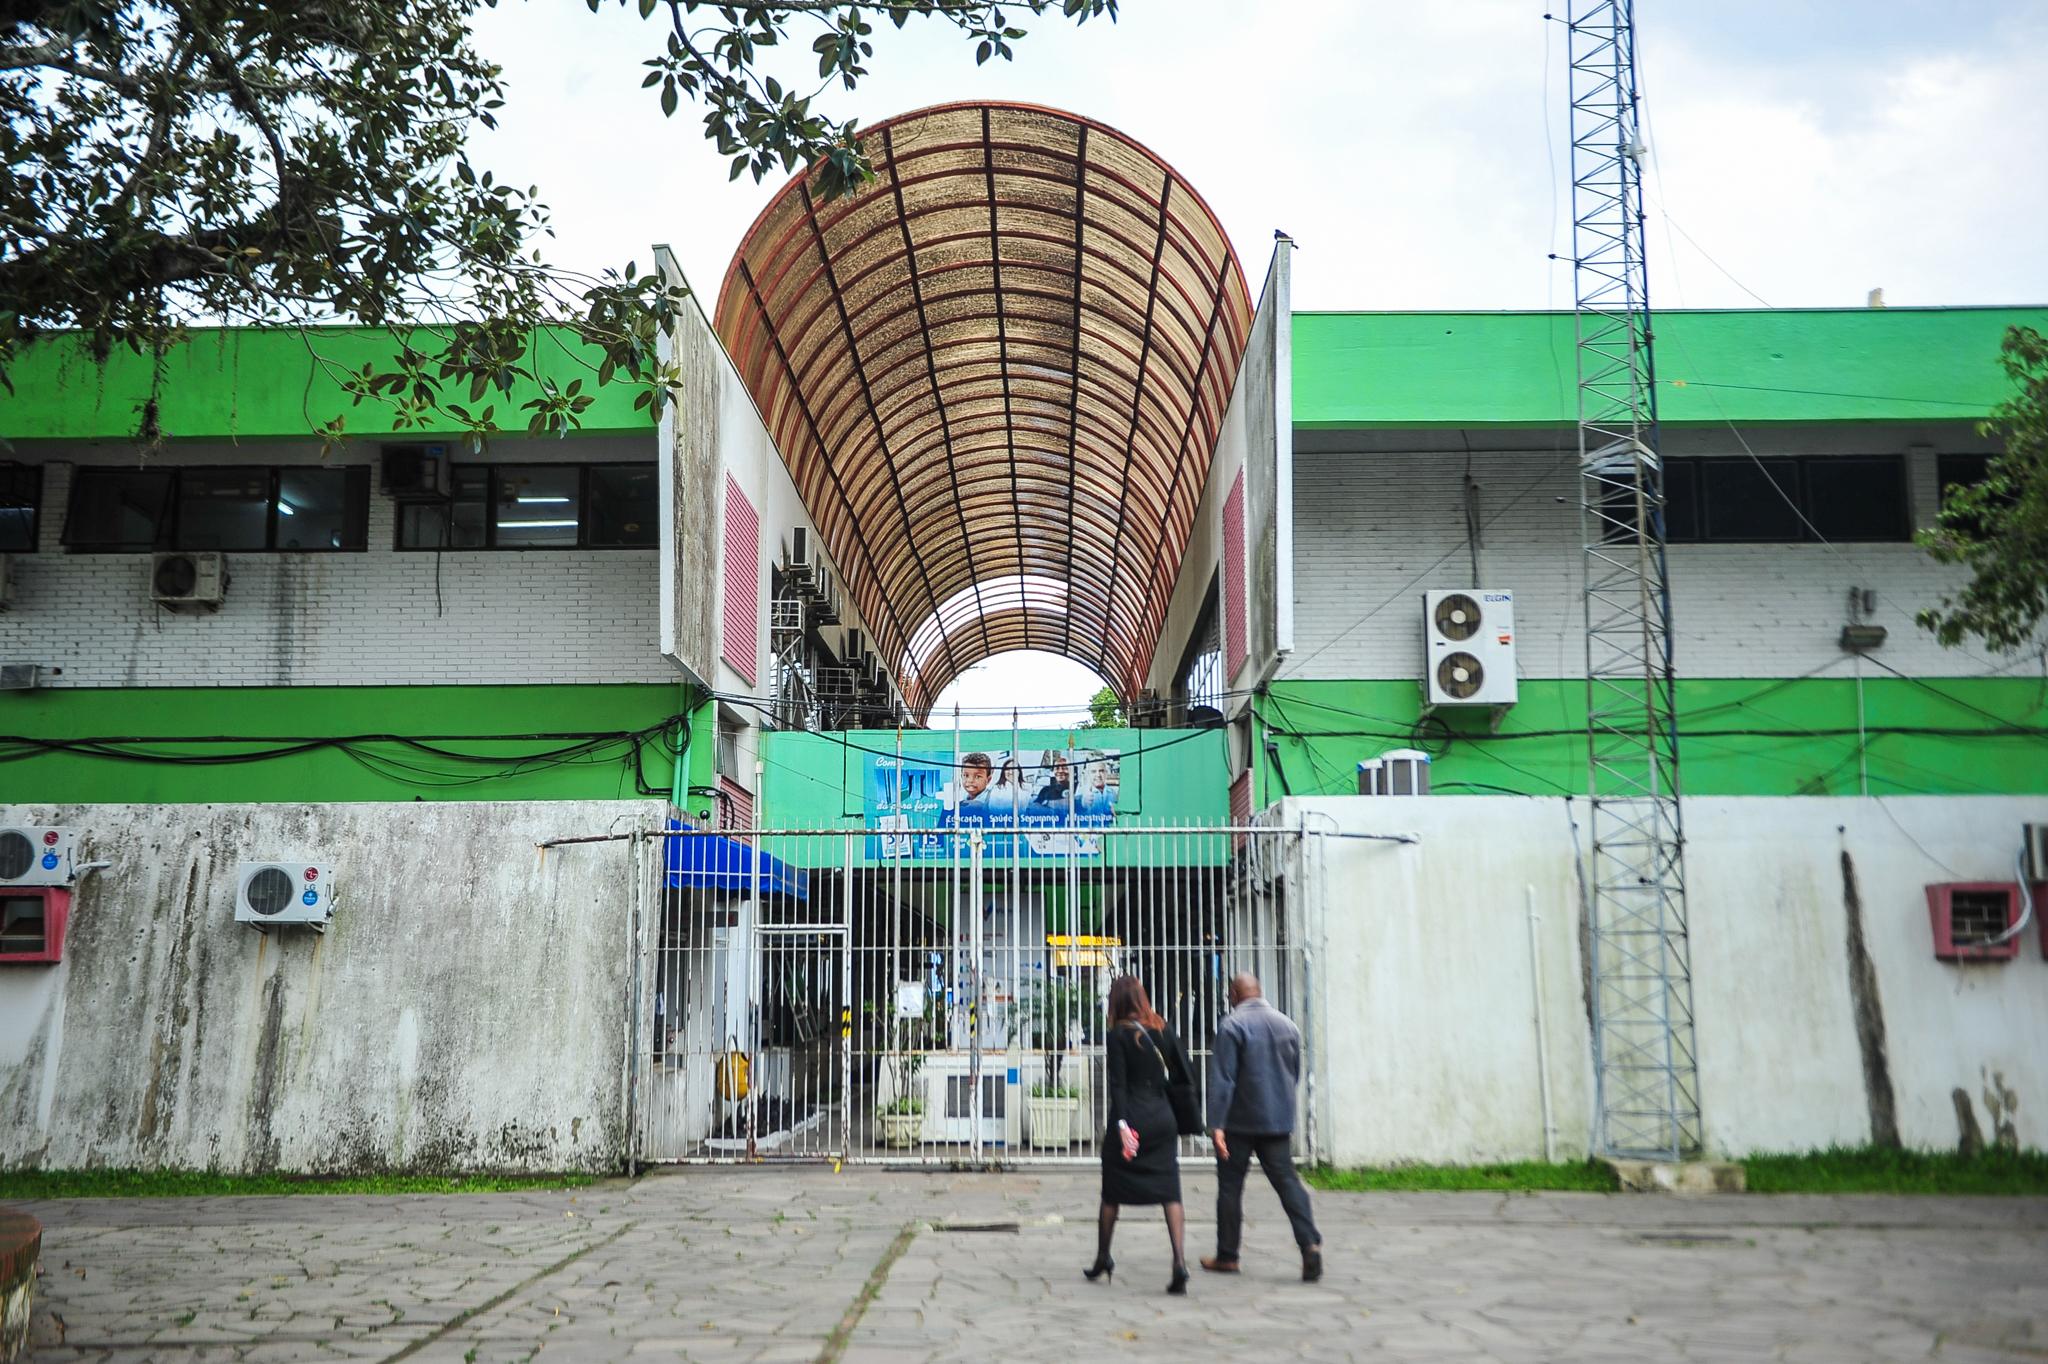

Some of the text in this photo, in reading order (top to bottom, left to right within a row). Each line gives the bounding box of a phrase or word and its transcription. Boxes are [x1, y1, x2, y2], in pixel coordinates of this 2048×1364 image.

[875, 769, 940, 802] IPTU
[889, 803, 913, 813] pra
[946, 814, 982, 823] Edcação
